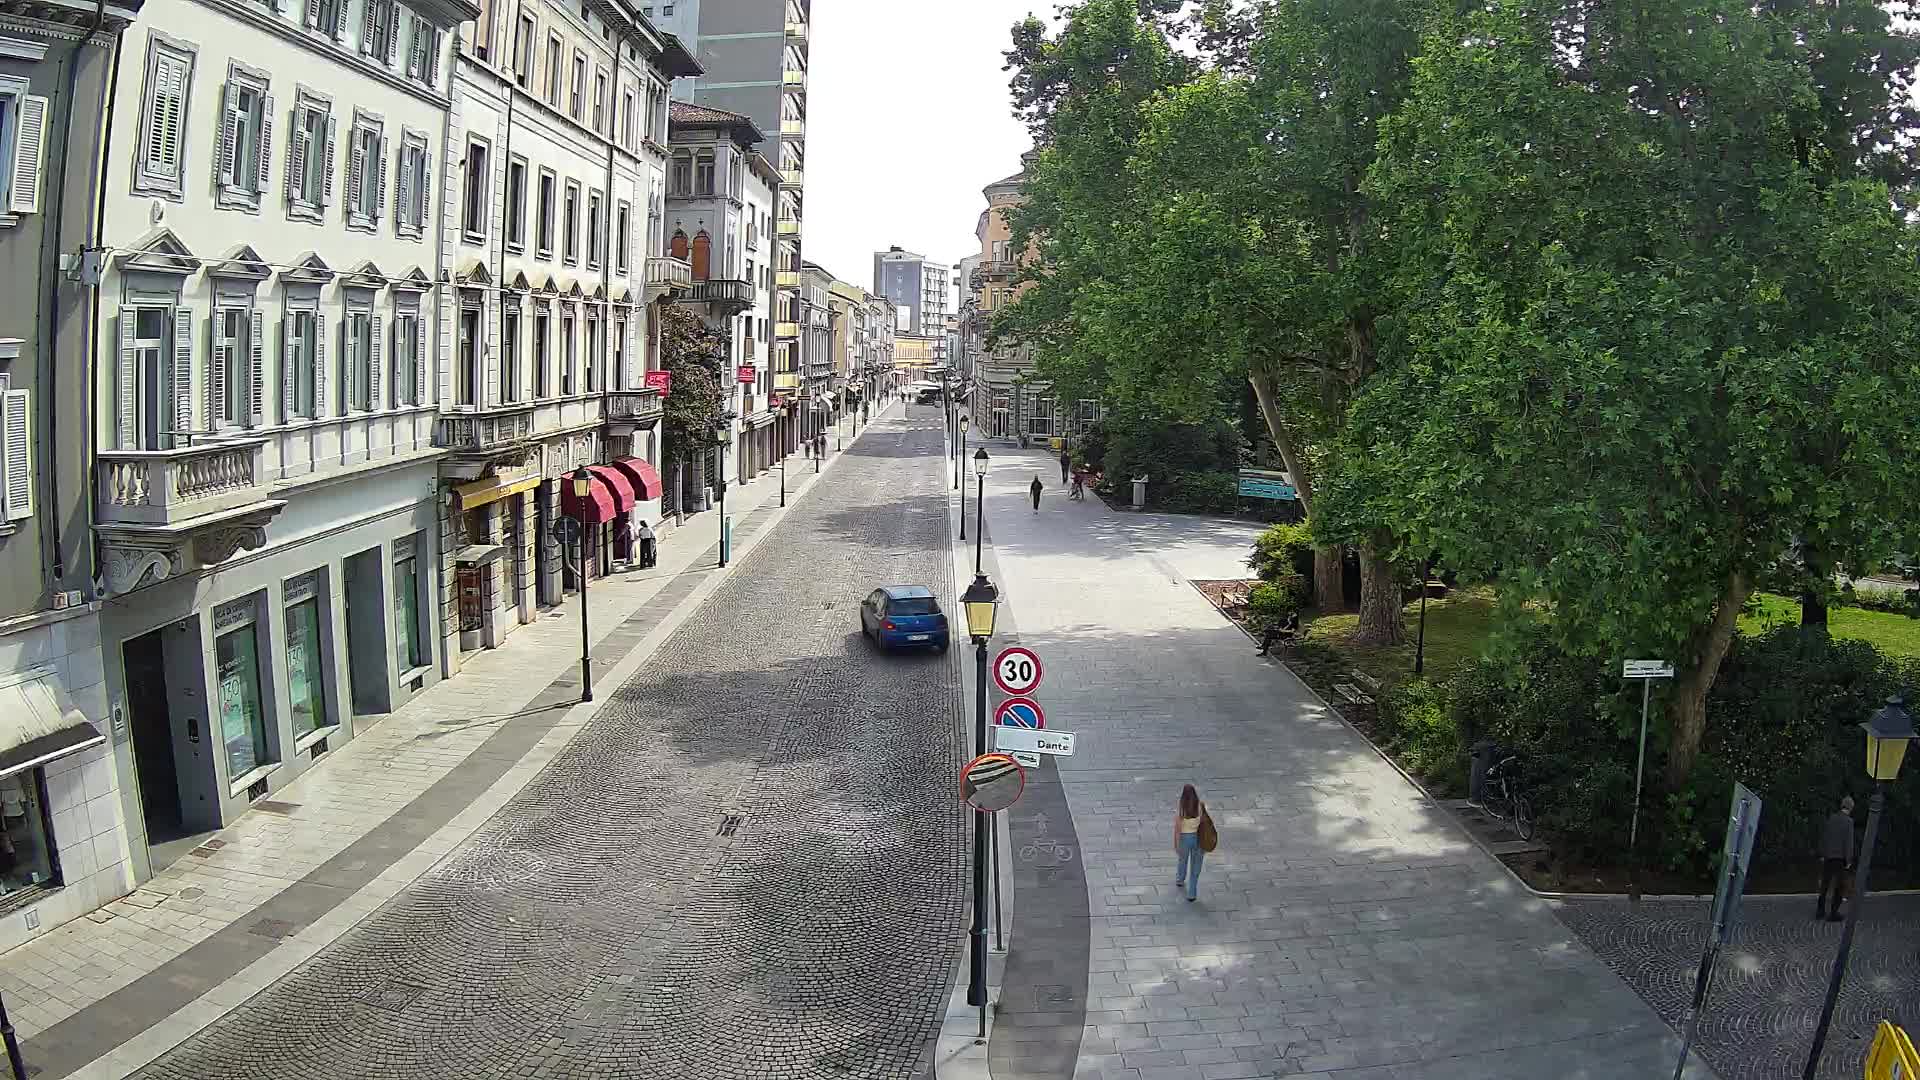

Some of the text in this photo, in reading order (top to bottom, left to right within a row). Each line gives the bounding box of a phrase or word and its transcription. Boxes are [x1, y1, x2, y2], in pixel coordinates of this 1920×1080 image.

[1005, 660, 1032, 682] 30
[221, 679, 240, 702] 130
[1037, 740, 1069, 751] Dante
